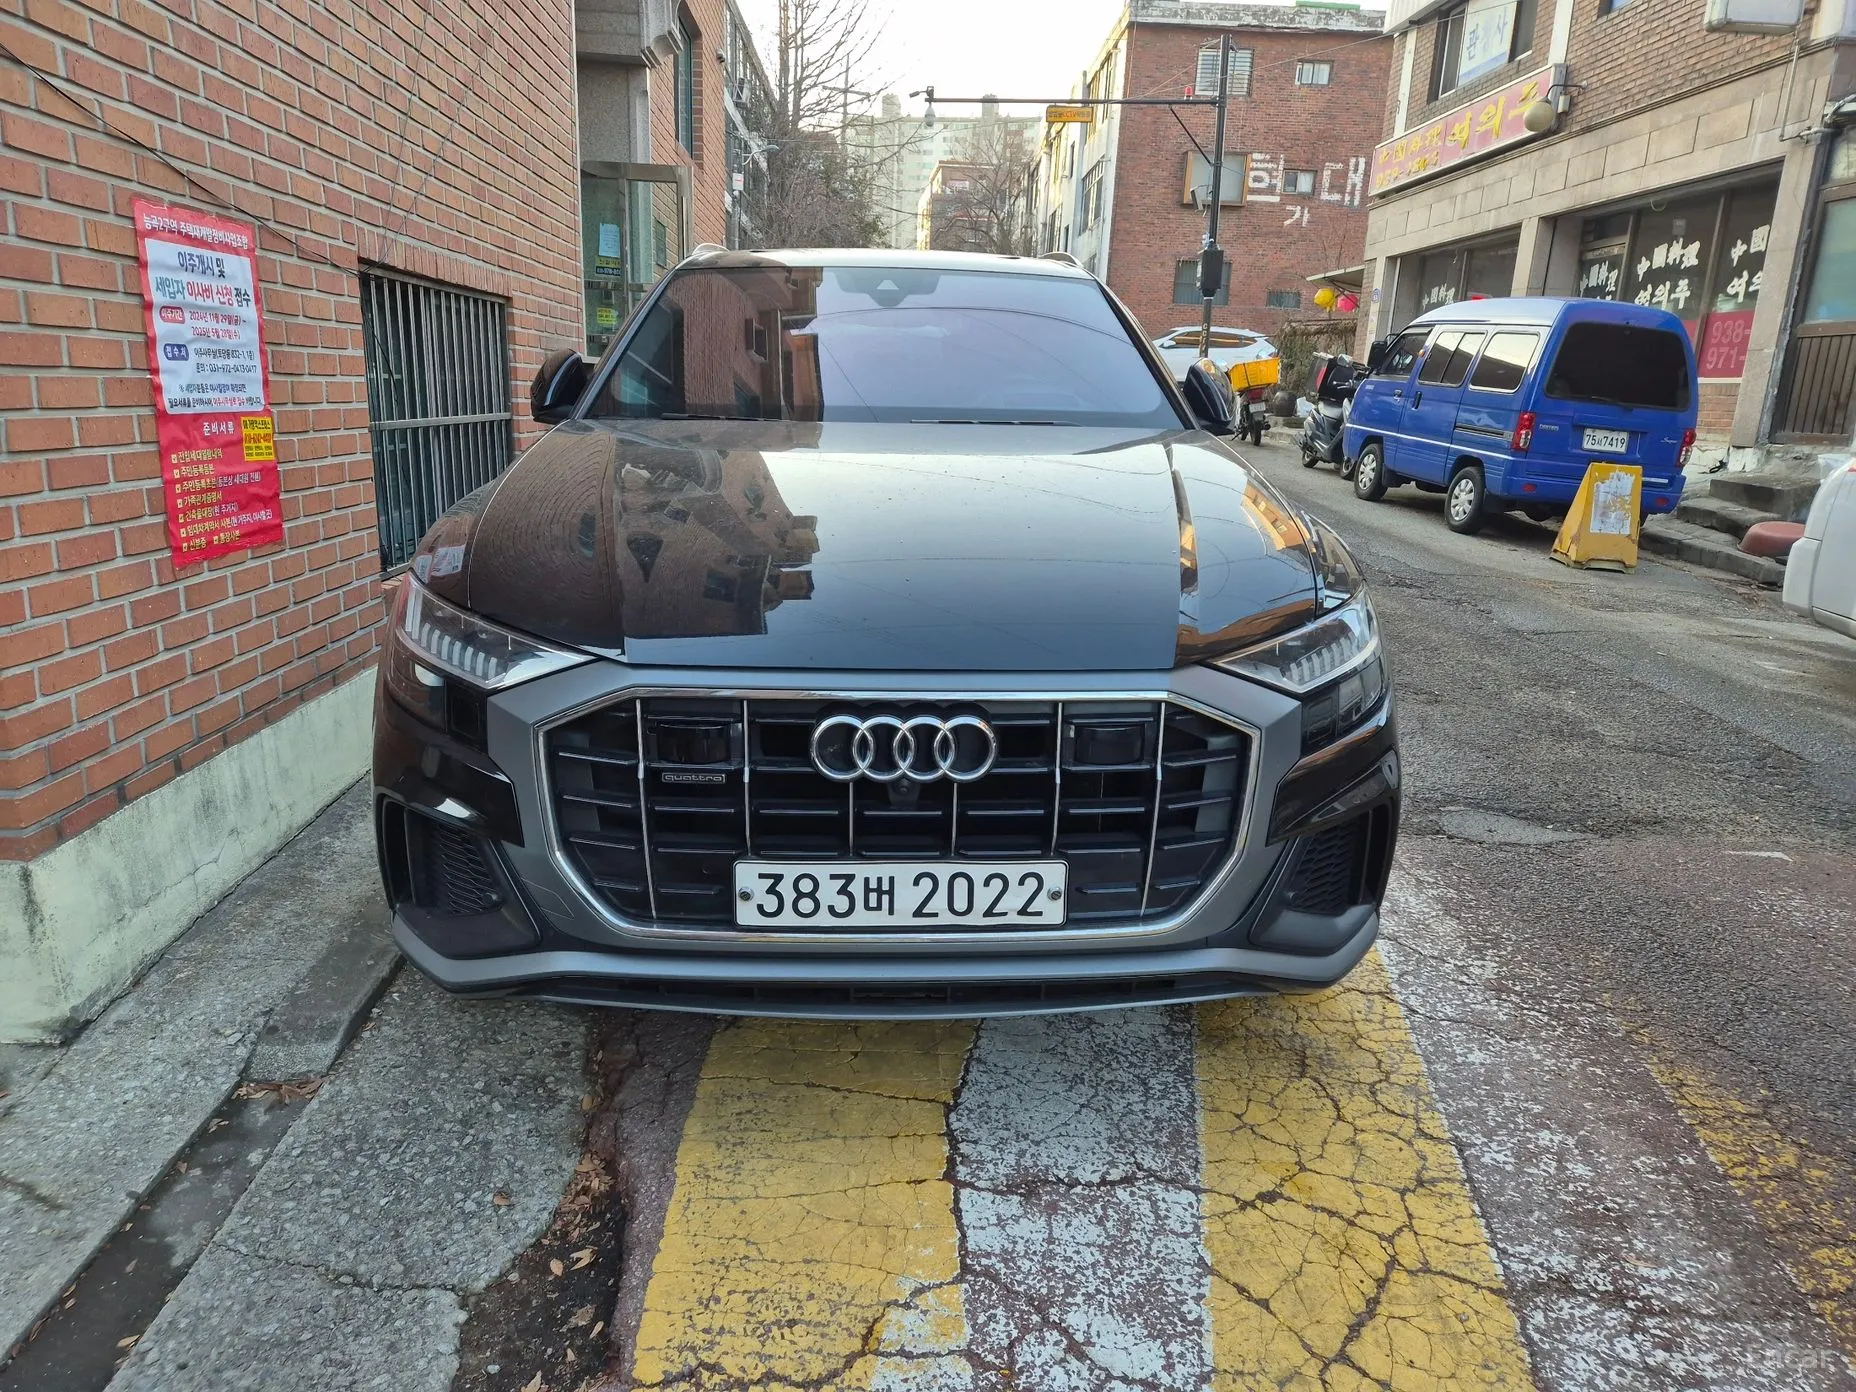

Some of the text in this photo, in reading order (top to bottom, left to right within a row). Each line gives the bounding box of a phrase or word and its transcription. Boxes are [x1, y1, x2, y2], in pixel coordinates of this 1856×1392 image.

[178, 251, 226, 278] 이주개시 및
[155, 276, 252, 307] 세입자 이사비 신청 접수
[161, 308, 183, 320] 이주기간
[203, 421, 235, 436] 준비서류
[665, 774, 722, 784] quattro
[912, 871, 1044, 919] 2022
